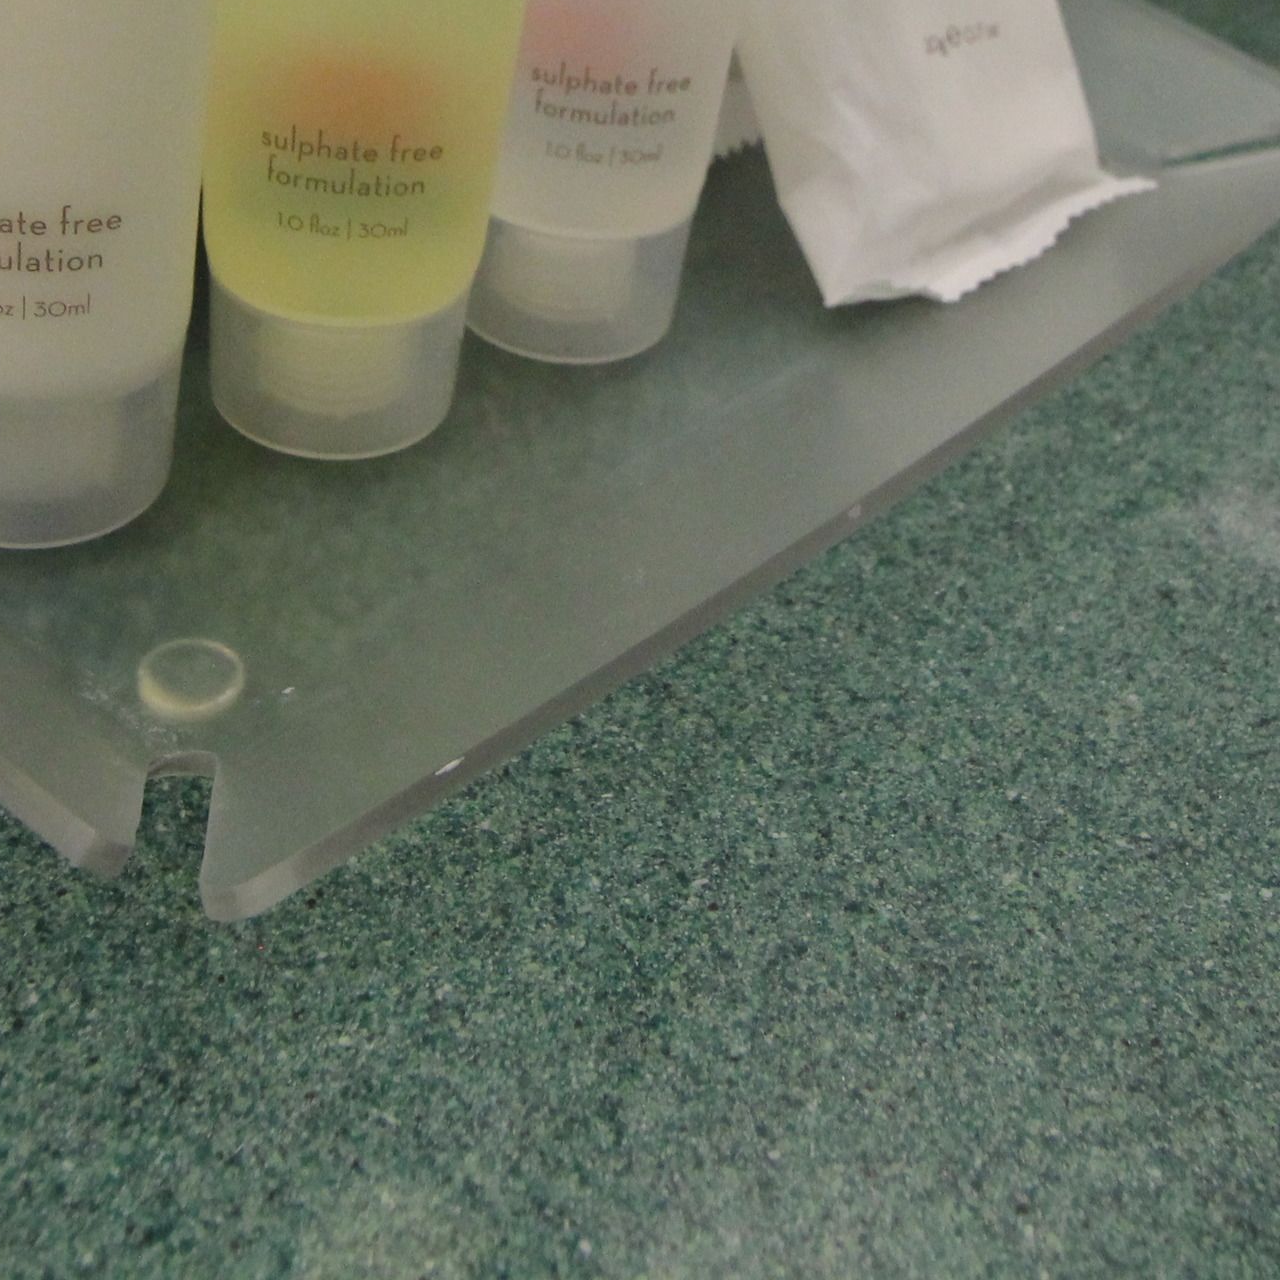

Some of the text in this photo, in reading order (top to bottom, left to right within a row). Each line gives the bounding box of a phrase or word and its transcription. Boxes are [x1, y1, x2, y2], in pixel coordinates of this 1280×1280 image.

[532, 61, 692, 96] sulphate free
[534, 88, 676, 126] formulation
[261, 124, 444, 163] sulphate free
[267, 154, 426, 197] formulation
[61, 205, 123, 235] free
[33, 293, 91, 318] 30ml
